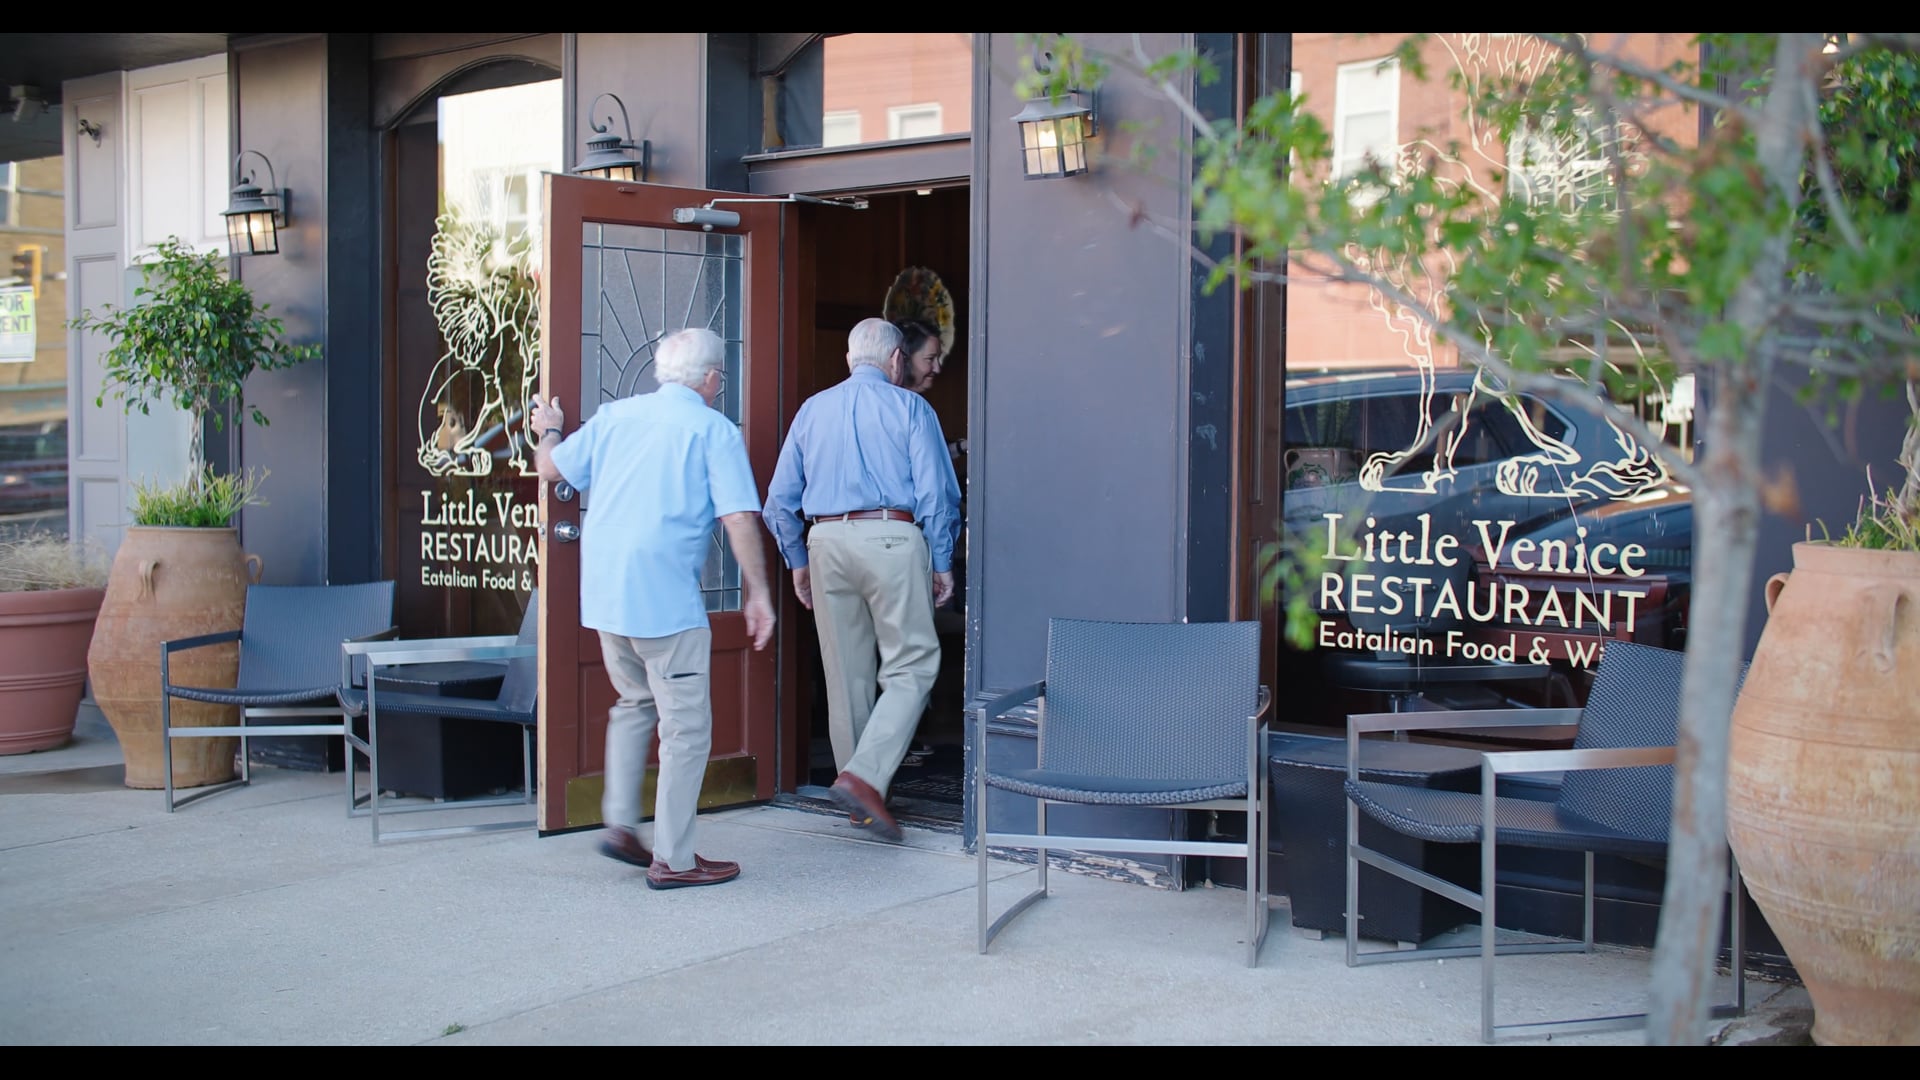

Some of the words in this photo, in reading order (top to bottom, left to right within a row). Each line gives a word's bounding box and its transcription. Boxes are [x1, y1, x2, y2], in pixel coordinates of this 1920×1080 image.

[0, 314, 31, 333] ENT
[420, 488, 488, 526] Little
[421, 531, 539, 565] RESTAURA
[1321, 512, 1459, 567] Little
[1471, 519, 1647, 577] Venice
[421, 566, 477, 588] Eatalian
[482, 569, 516, 591] Food
[521, 570, 532, 592] &
[1320, 571, 1646, 633] RESTAURANT
[1319, 620, 1434, 656] Eatalian
[1446, 630, 1516, 664] Food
[1528, 636, 1551, 666] &
